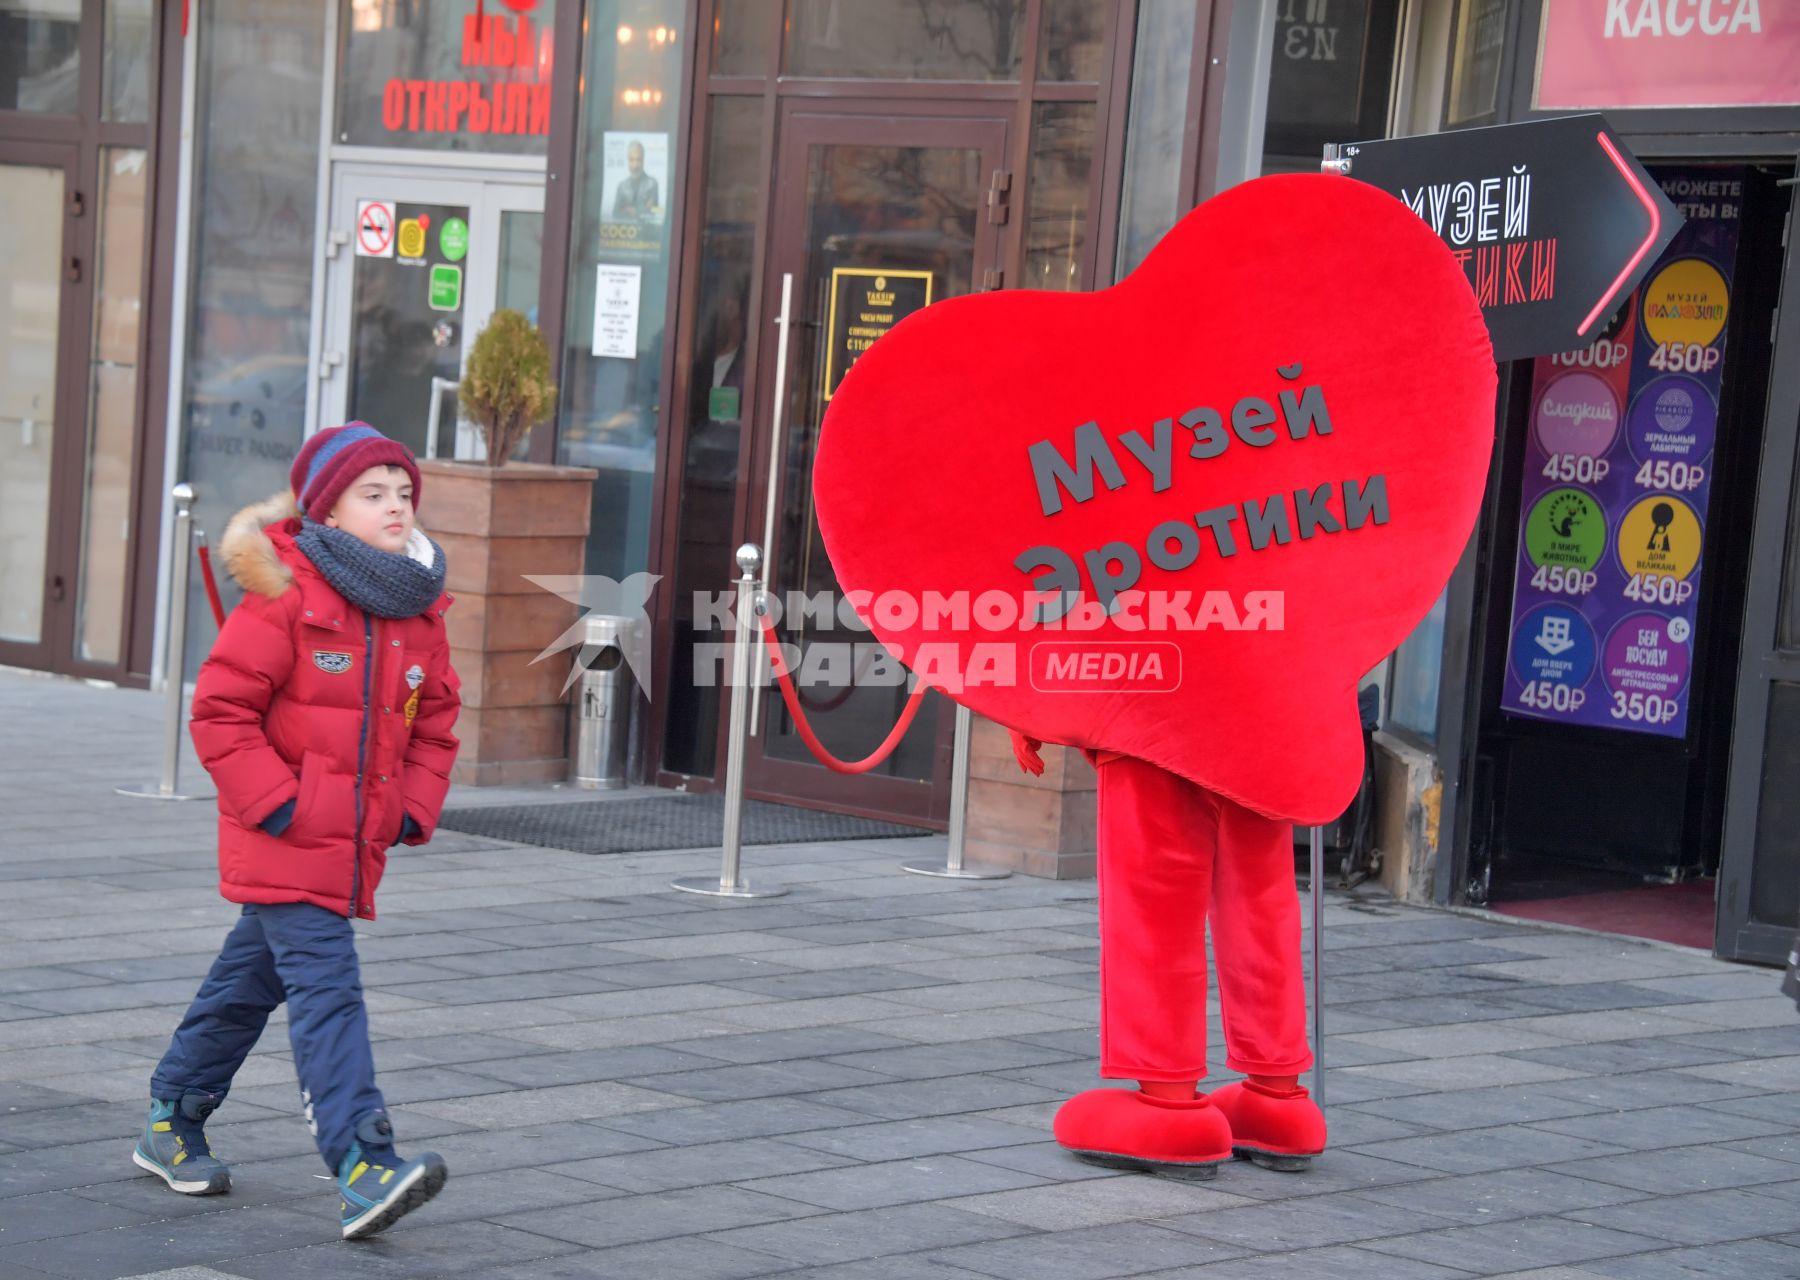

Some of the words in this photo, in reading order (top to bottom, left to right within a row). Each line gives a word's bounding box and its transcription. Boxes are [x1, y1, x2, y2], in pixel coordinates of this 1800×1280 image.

[1604, 0, 1762, 38] КАССА
[462, 15, 536, 67] МЫ
[383, 78, 550, 136] ОТКРЫЛИ
[1346, 147, 1361, 157] 18+
[1674, 203, 1716, 219] ЕТЫ
[1721, 204, 1738, 219] В:
[1649, 342, 1719, 373] 450₽
[1543, 398, 1613, 426] Сладкий
[1028, 363, 1333, 516] Музей
[1644, 433, 1696, 444] ЗЕРКАЛЬНЫЙ
[1542, 454, 1609, 484] 450₽
[1635, 460, 1704, 490] 450₽
[1013, 474, 1390, 624] Эротики
[1541, 552, 1587, 564] ЖИВОТНЫХ
[1558, 543, 1580, 552] МИРЕ
[1531, 564, 1597, 595] 450₽
[1624, 574, 1692, 605] 450₽
[1611, 668, 1678, 683] АНТИСТРЕССОВЫЙ
[1519, 681, 1585, 712] 450₽
[1610, 691, 1678, 724] 350₽
